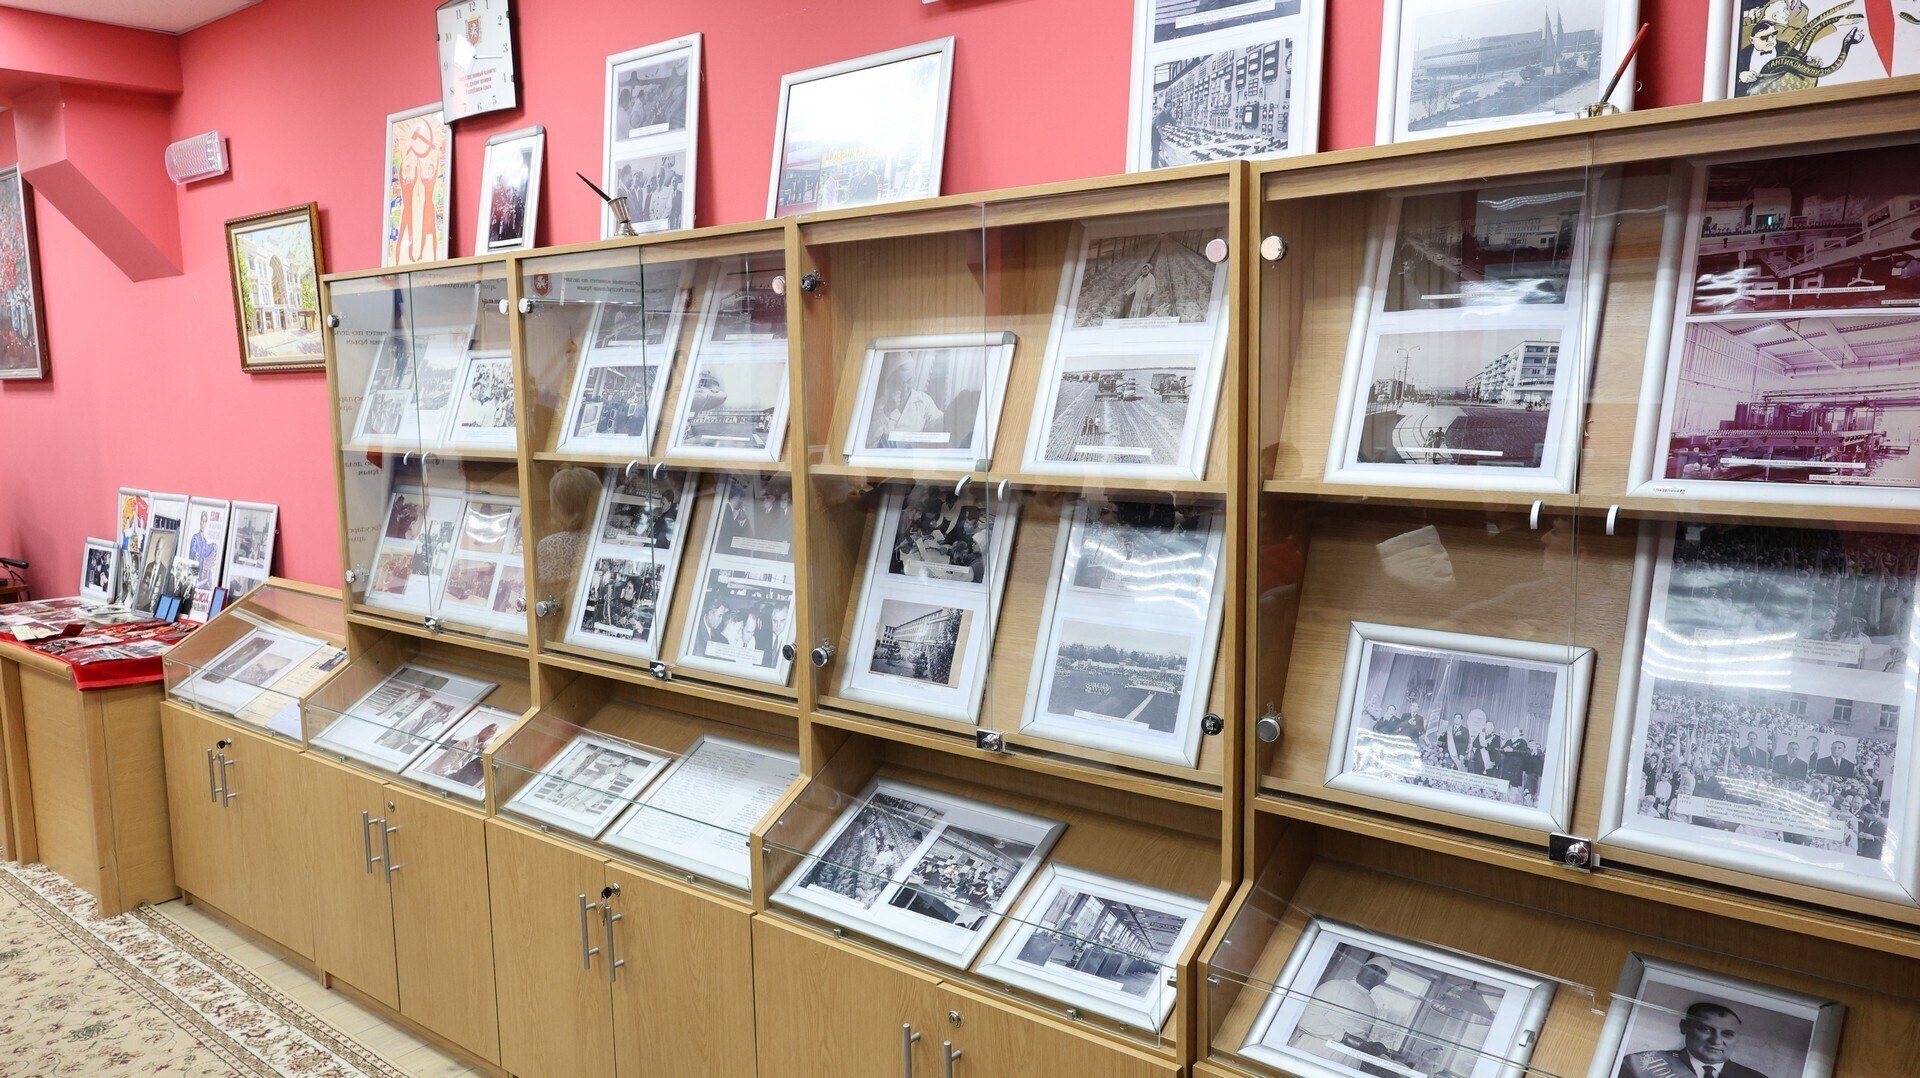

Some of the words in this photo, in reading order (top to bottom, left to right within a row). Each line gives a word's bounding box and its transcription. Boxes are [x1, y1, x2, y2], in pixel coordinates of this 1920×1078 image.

[468, 1, 476, 13] 12
[455, 9, 462, 20] 11
[497, 15, 503, 26] 2
[503, 43, 509, 54] 3
[1770, 58, 1831, 76] АНТИКОММУНИЗМ
[449, 87, 455, 97] 8
[492, 95, 498, 106] 5
[462, 102, 468, 113] 7
[477, 102, 483, 112] 6
